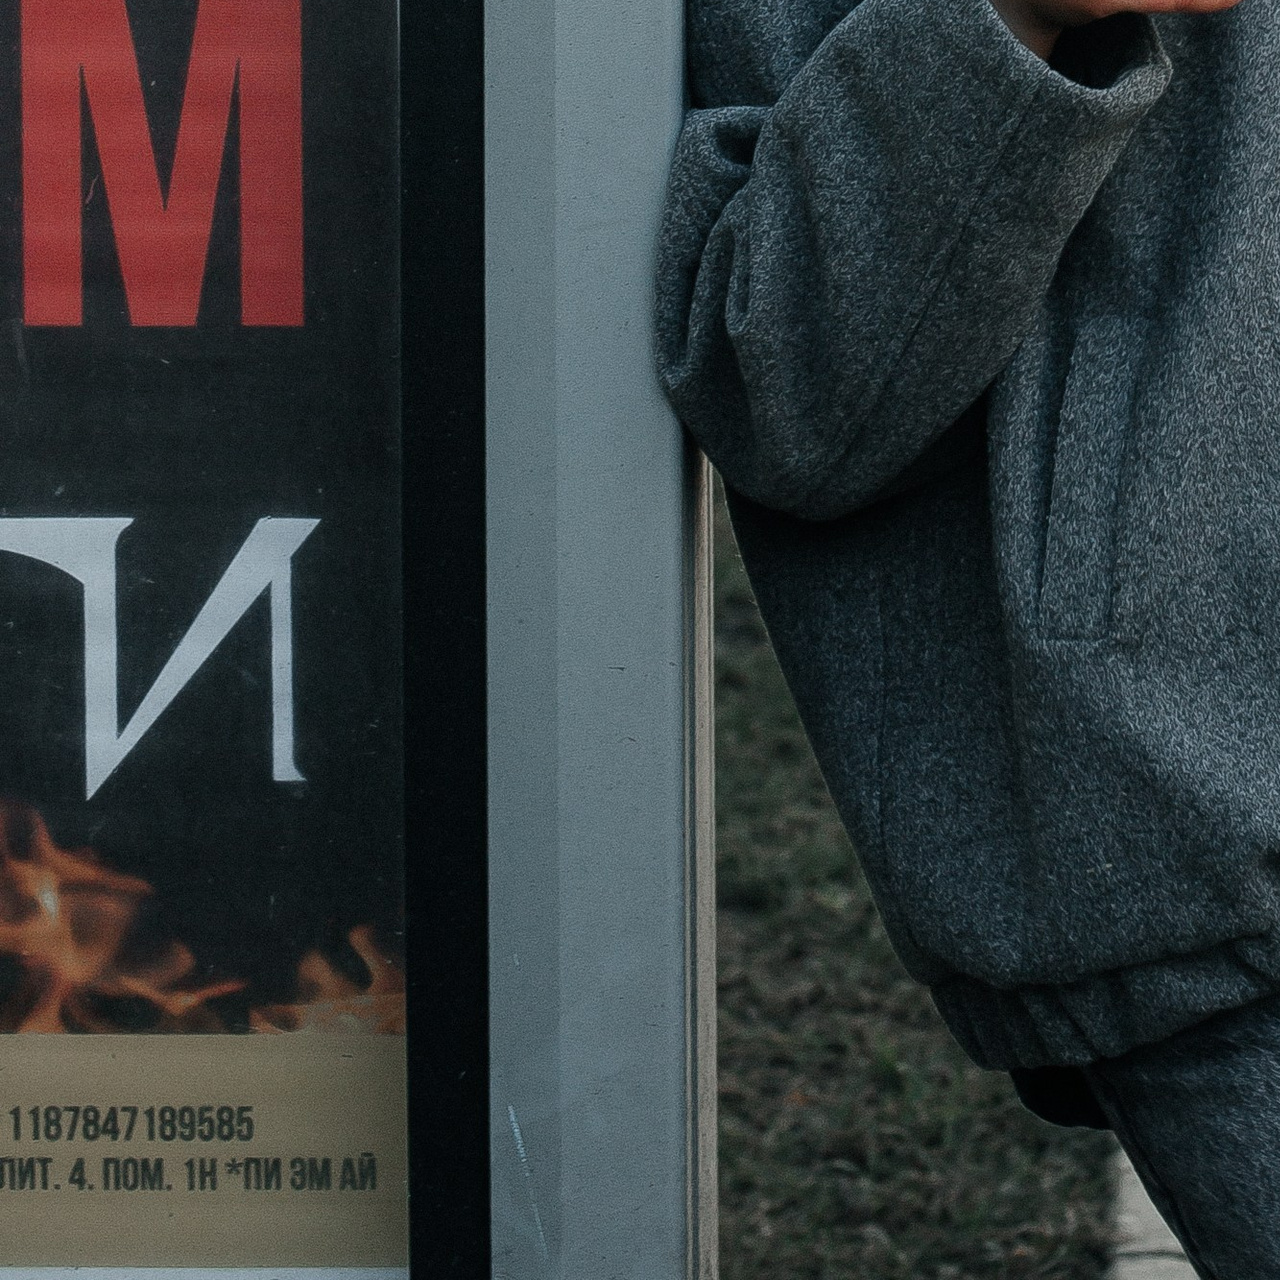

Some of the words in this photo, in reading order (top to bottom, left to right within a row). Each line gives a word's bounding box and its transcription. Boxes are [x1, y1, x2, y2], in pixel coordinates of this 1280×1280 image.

[8, 1105, 256, 1142] 1187847189585
[68, 1157, 94, 1191] 4.
[103, 1156, 173, 1191] ПОМ.
[184, 1157, 218, 1191] 1Н
[289, 1157, 332, 1191] ЭМ
[339, 1151, 378, 1191] АЙ
